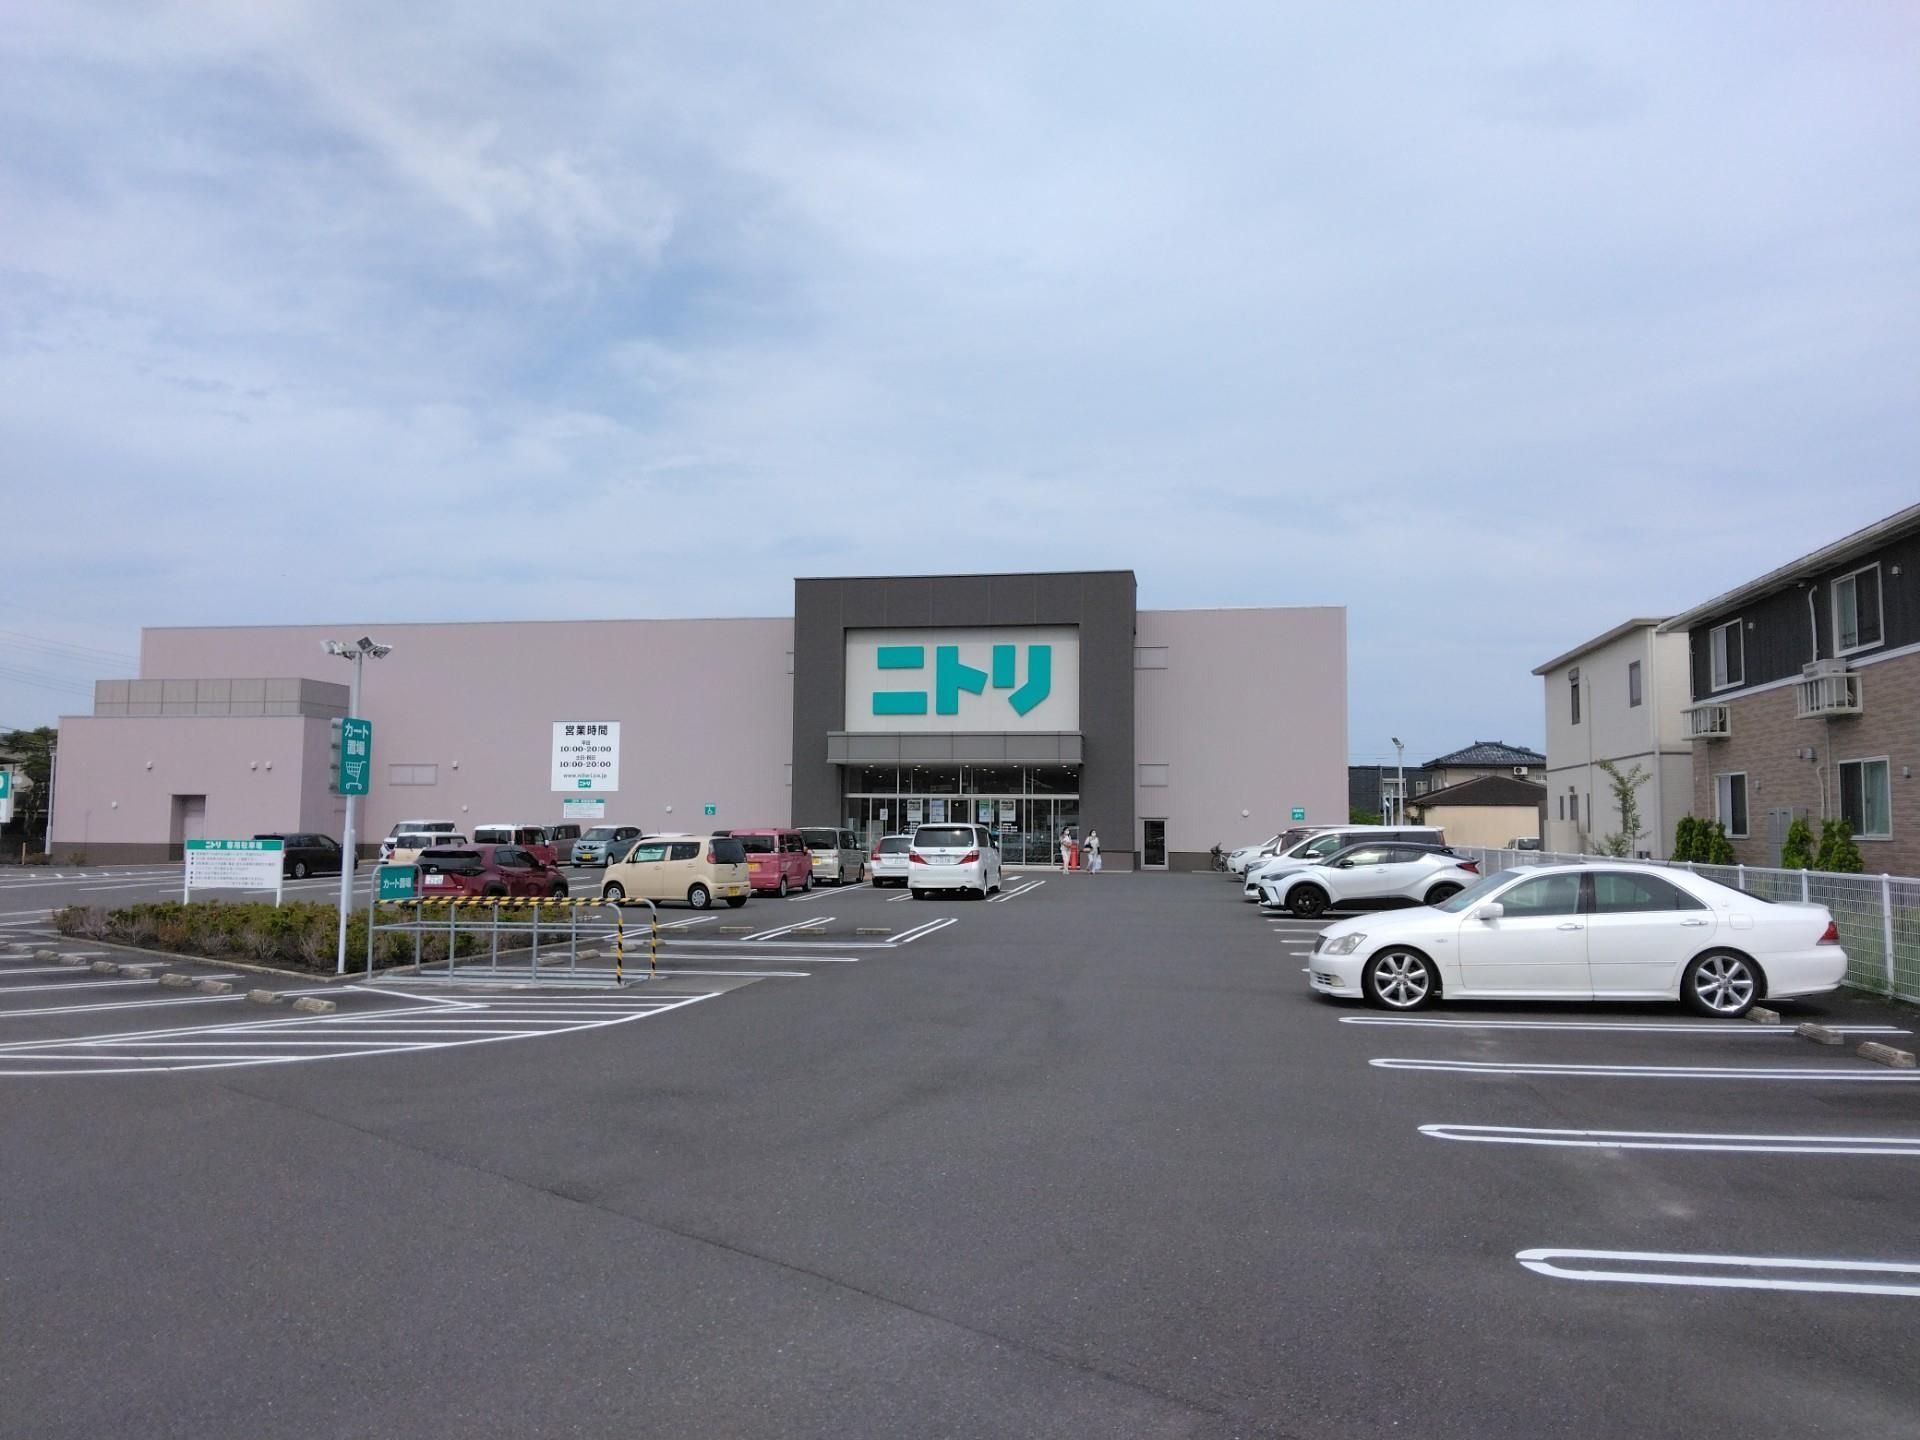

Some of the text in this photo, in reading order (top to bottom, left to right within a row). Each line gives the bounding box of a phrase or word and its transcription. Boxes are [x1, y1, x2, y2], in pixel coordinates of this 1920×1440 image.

[873, 644, 1052, 717] ニトリ
[345, 723, 369, 738] カート
[565, 725, 608, 736] 営業時間
[347, 740, 366, 755] 置場
[383, 877, 411, 889] カート置場
